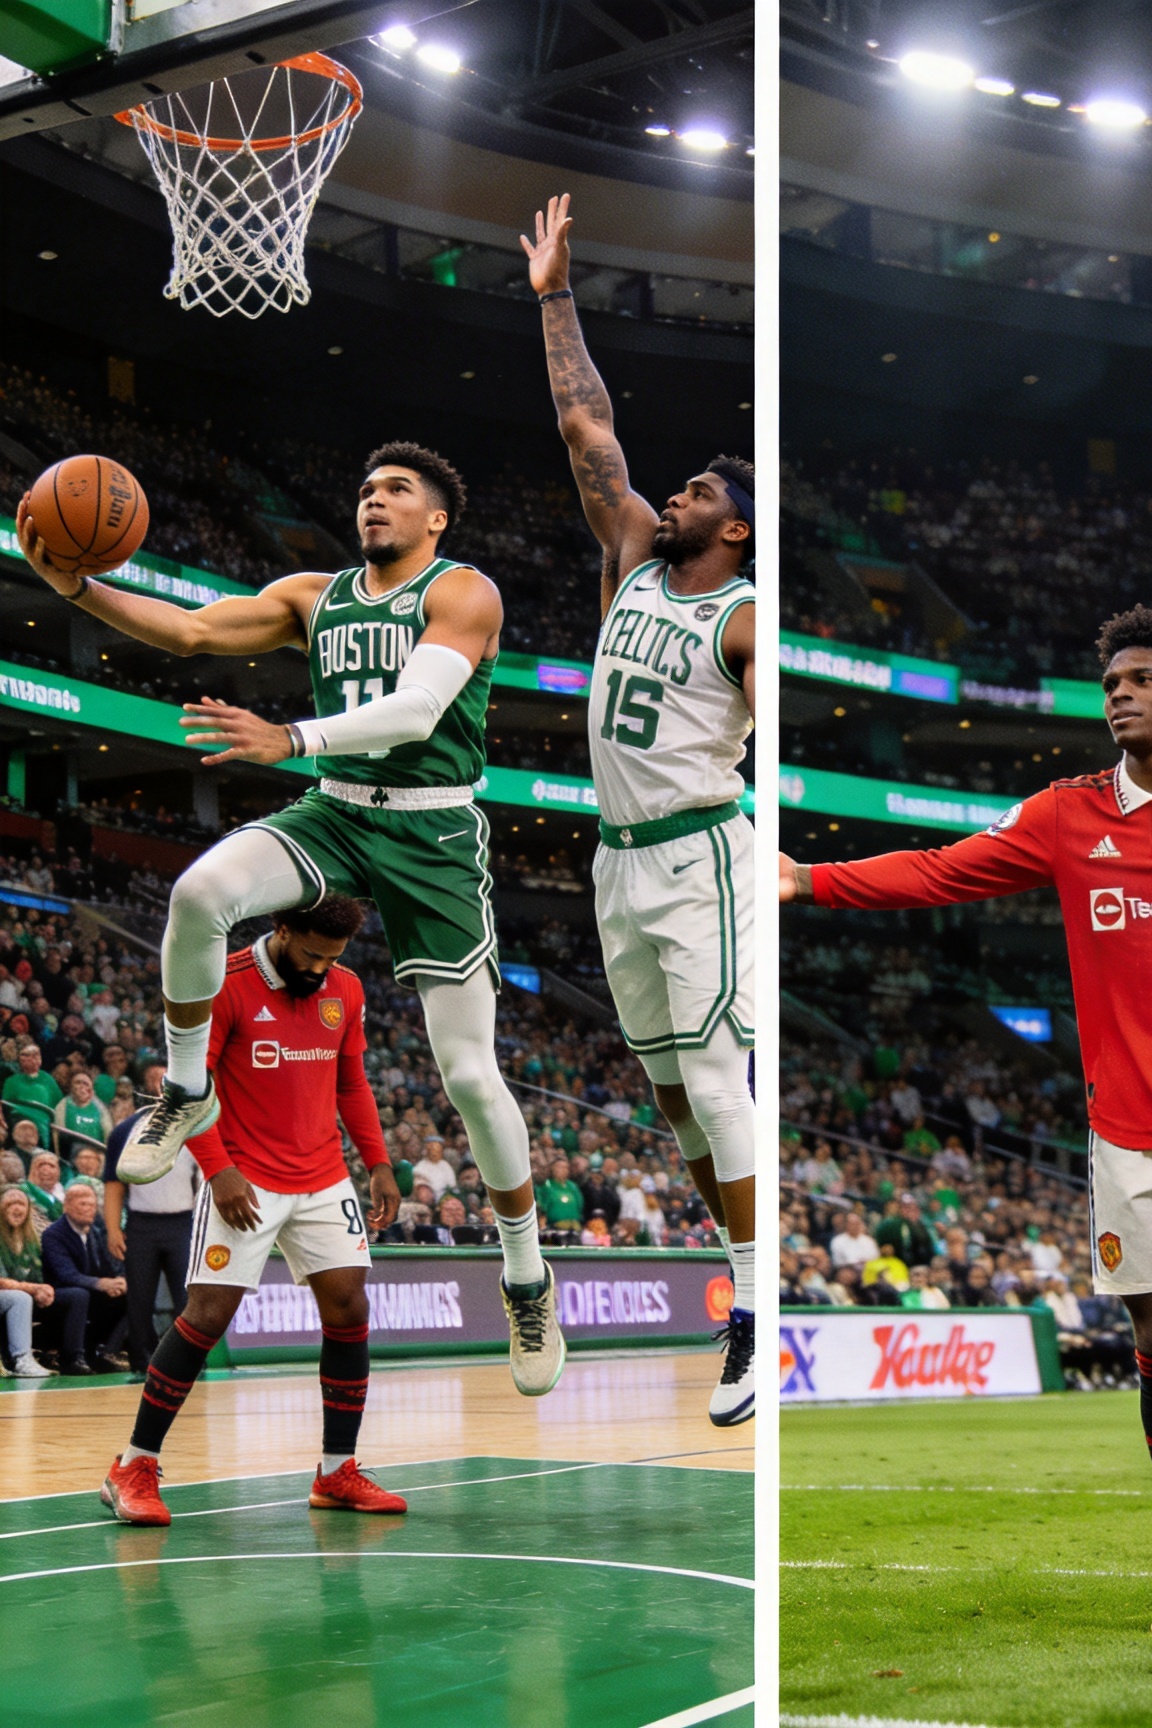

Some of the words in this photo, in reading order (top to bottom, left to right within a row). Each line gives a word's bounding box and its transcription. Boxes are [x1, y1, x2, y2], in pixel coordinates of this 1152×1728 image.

[318, 621, 414, 678] BOSTON
[601, 669, 665, 750] 15
[341, 1198, 363, 1235] 8
